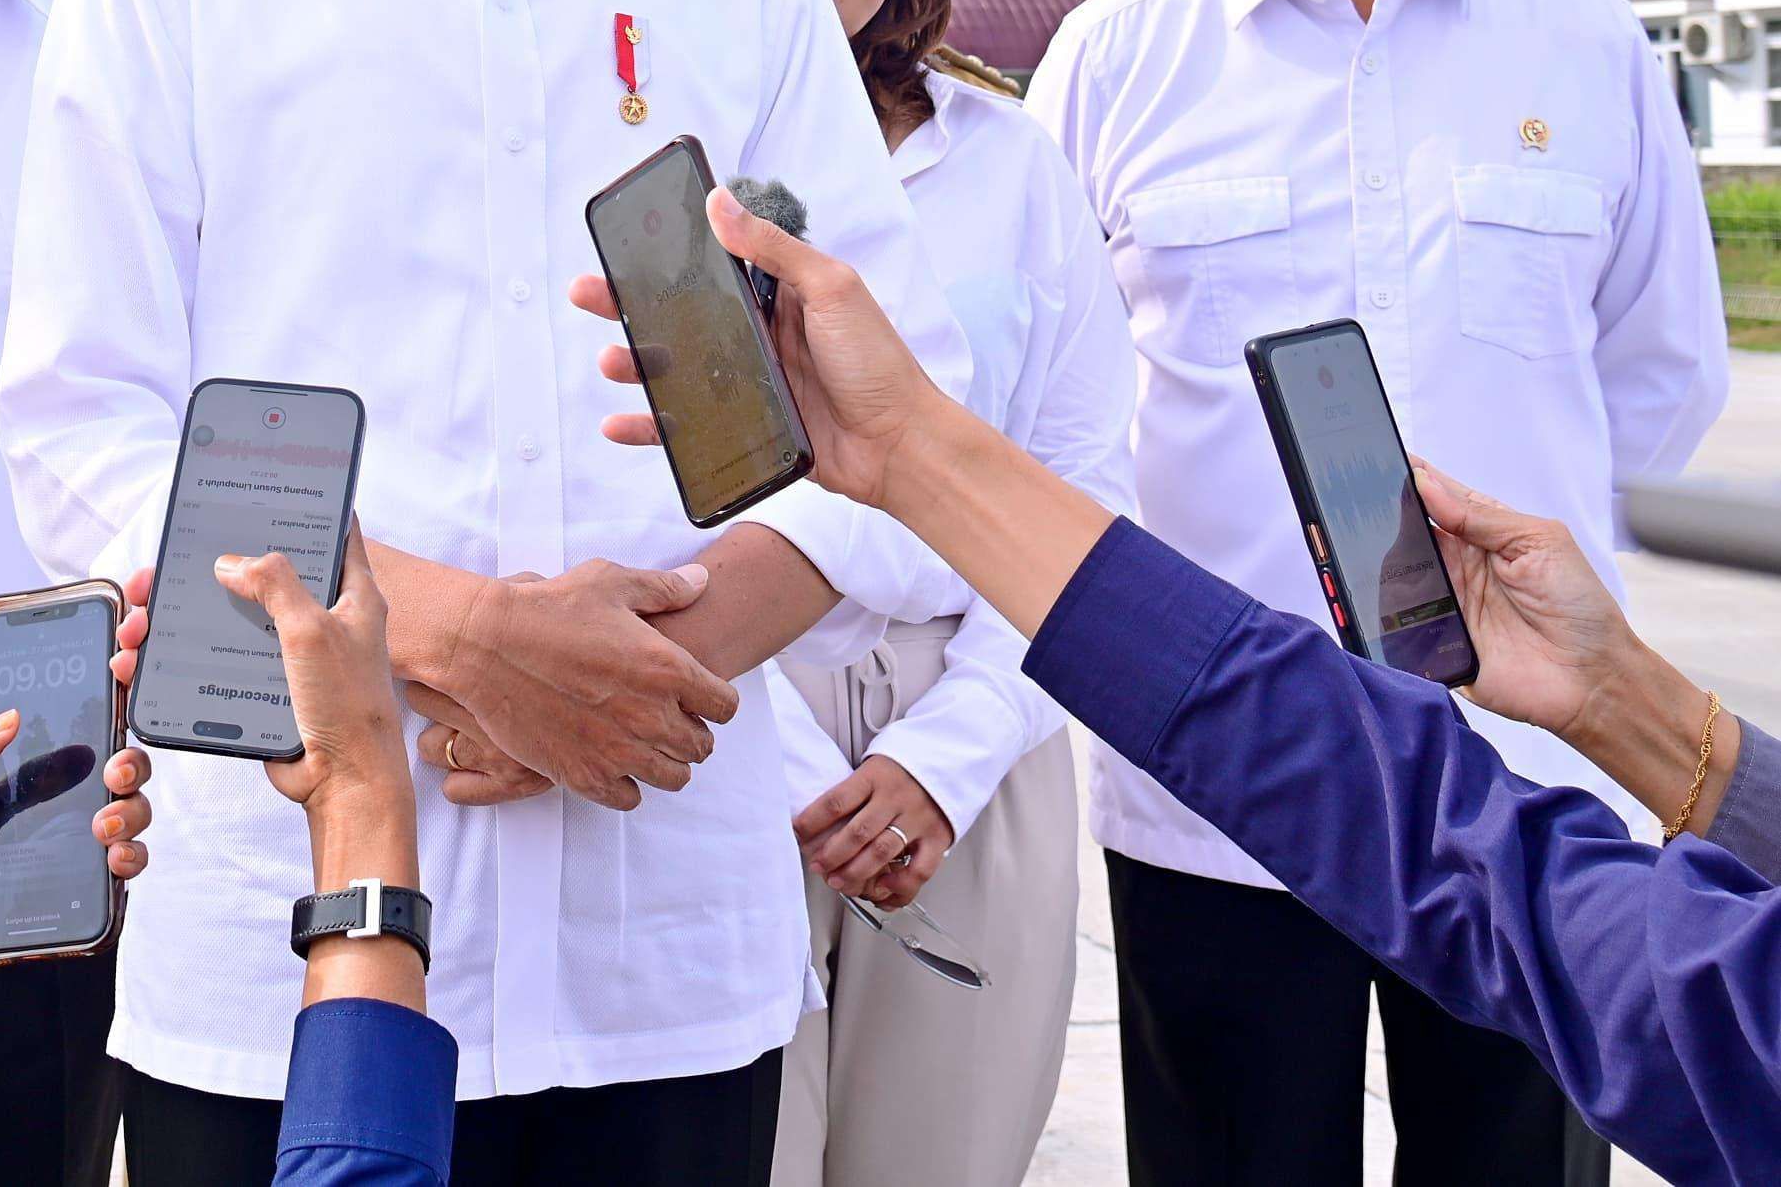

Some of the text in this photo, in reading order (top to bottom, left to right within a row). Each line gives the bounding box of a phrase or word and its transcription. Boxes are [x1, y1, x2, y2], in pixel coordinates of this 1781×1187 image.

[197, 478, 324, 498] Simpang Susun Limapuluh 2
[311, 523, 332, 531] Jalan
[307, 549, 328, 557] Jalan
[210, 645, 250, 656] Limapuluh
[251, 650, 275, 659] Susun
[198, 684, 281, 706] Recordings
